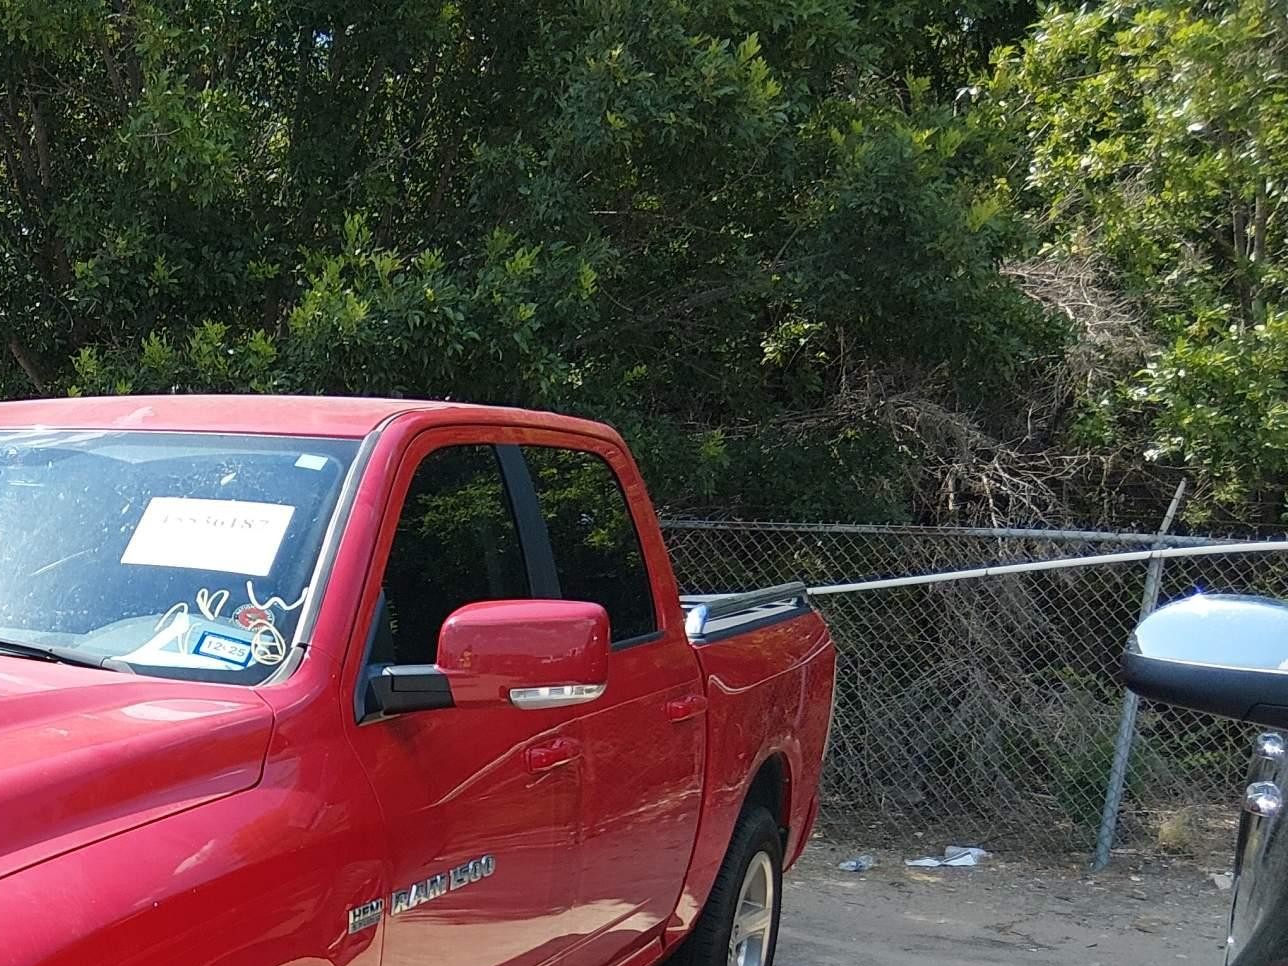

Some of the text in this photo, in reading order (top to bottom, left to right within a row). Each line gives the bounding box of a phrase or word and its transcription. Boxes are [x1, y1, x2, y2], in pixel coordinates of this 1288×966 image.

[391, 853, 496, 916] RAM 1500
[352, 900, 383, 922] HEMI
